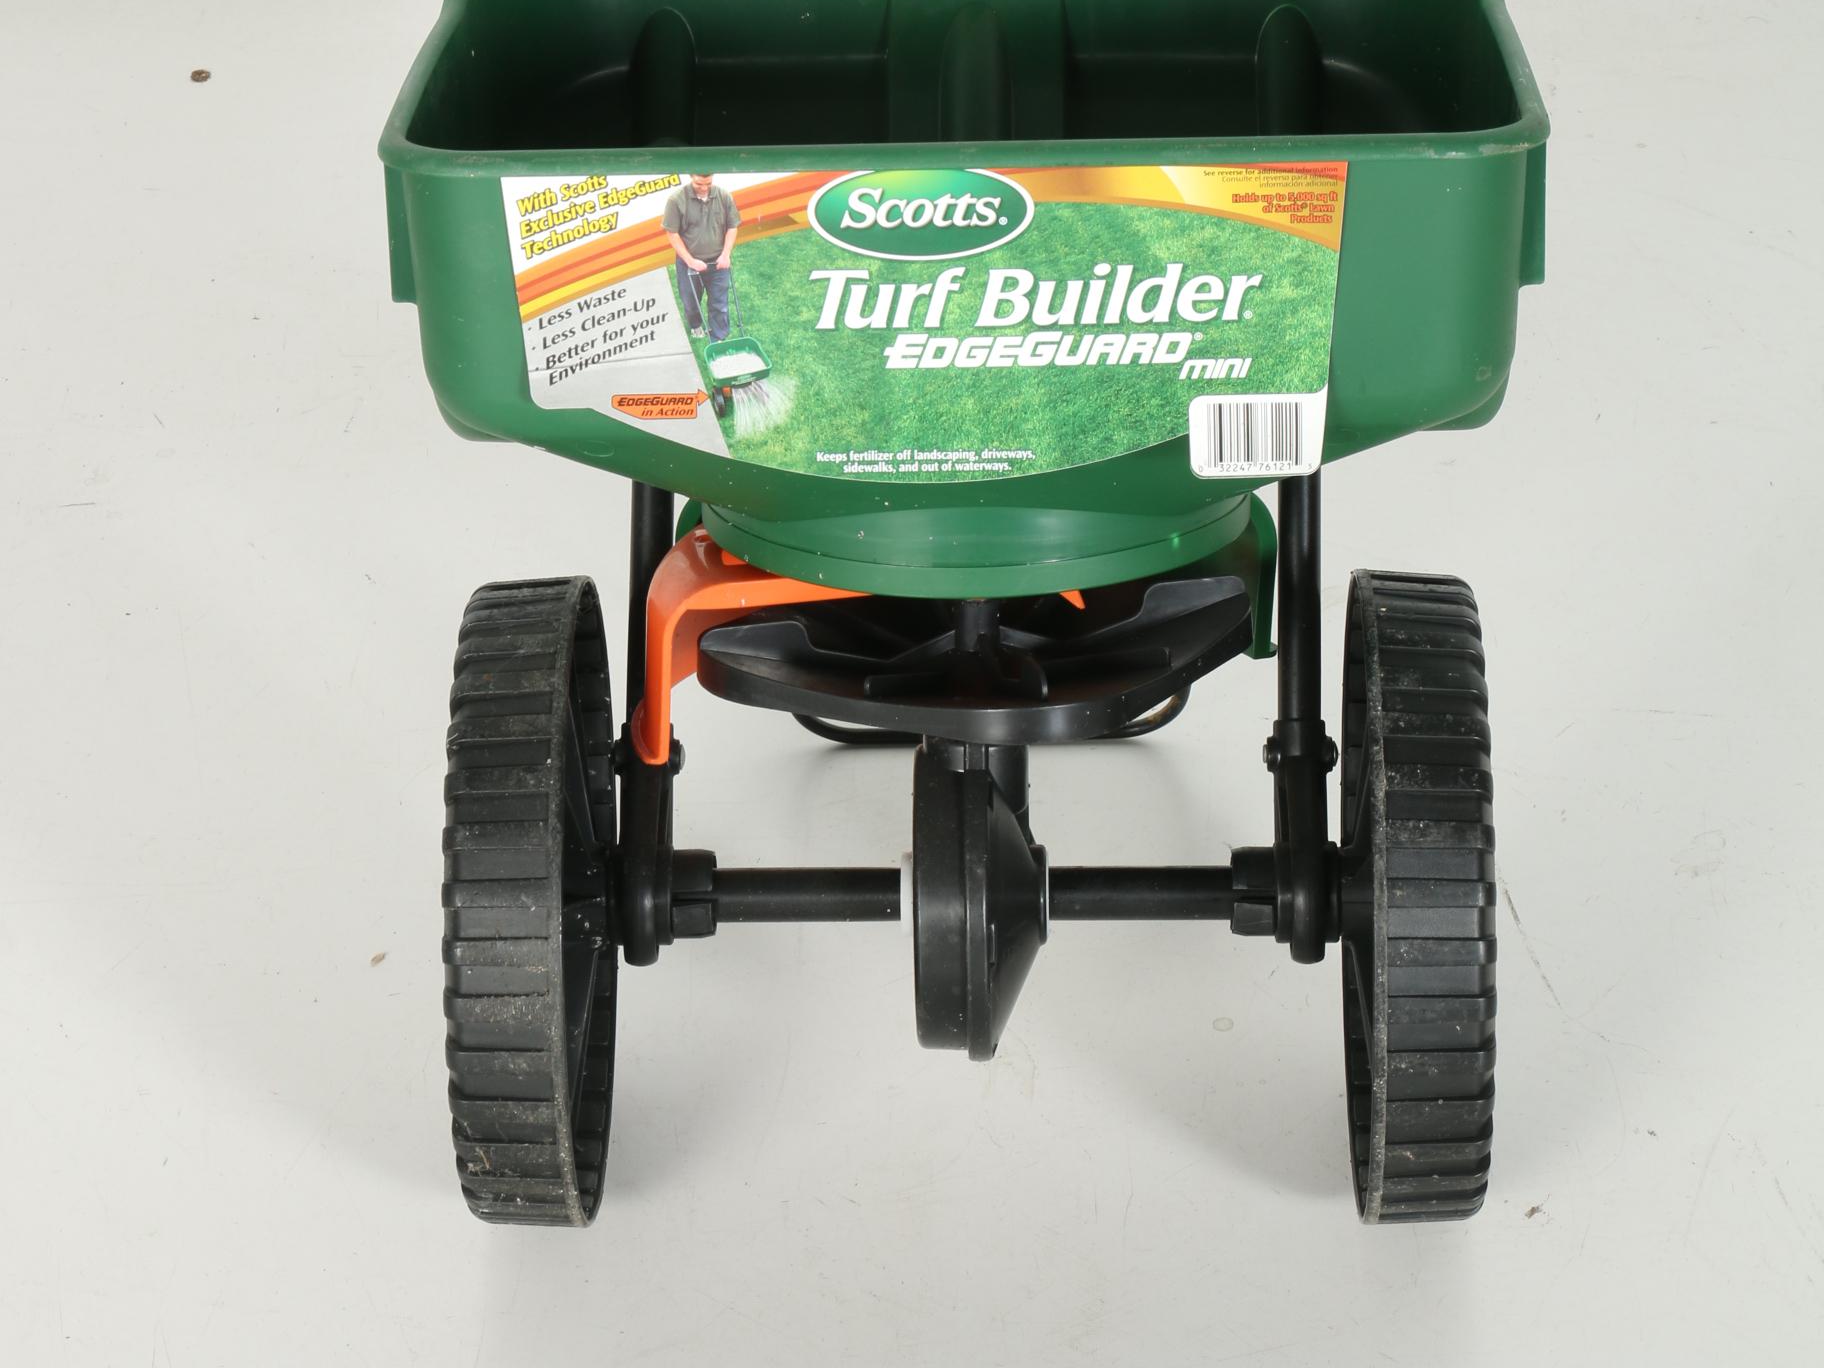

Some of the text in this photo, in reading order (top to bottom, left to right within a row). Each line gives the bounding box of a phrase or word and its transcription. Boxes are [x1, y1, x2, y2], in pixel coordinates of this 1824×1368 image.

[516, 175, 608, 217] With Scotts
[519, 173, 682, 239] Exclusive EdgeGuard
[840, 187, 1000, 230] Scotts
[1231, 192, 1260, 203] Holds
[1261, 194, 1274, 204] up
[1275, 192, 1286, 202] to
[1316, 193, 1327, 203] sq
[1328, 191, 1338, 201] ft
[1262, 203, 1273, 213] of
[1308, 202, 1335, 212] Lawn
[521, 211, 619, 260] Technology
[1290, 214, 1333, 224] Products
[537, 287, 628, 331] Less Waste
[808, 262, 1263, 330] Turf Builder
[542, 296, 656, 351] Less Clean-Up
[545, 312, 669, 370] Better for your
[548, 330, 656, 387] Environment
[883, 331, 1194, 369] EDGEGUARD
[641, 407, 694, 417] in Action
[816, 448, 1036, 463] Keeps fertilizer off landscaping, driveways,
[843, 461, 1013, 474] sidewalks, and out of waterways.
[1219, 463, 1253, 473] 32247
[1259, 463, 1292, 471] 76121
